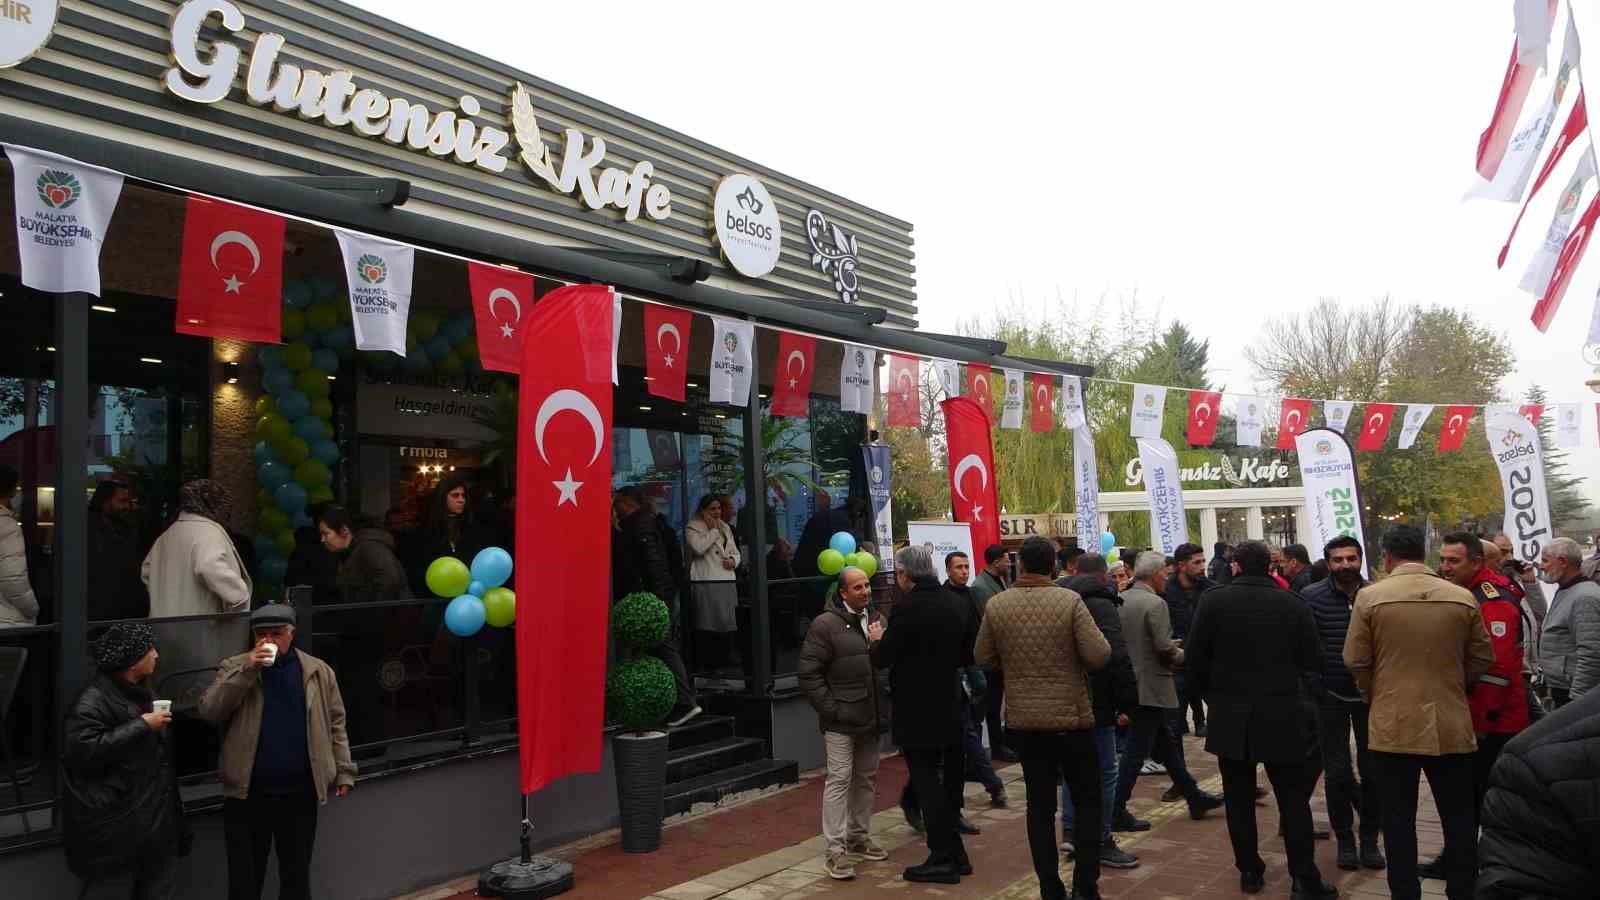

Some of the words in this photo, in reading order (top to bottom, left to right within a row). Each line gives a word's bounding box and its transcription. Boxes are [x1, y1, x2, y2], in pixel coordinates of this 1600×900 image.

[164, 0, 510, 173] Glutensiz
[559, 128, 673, 222] Kafe
[35, 211, 78, 224] MALATYA
[726, 209, 773, 241] belsos
[1238, 457, 1289, 483] Kafe
